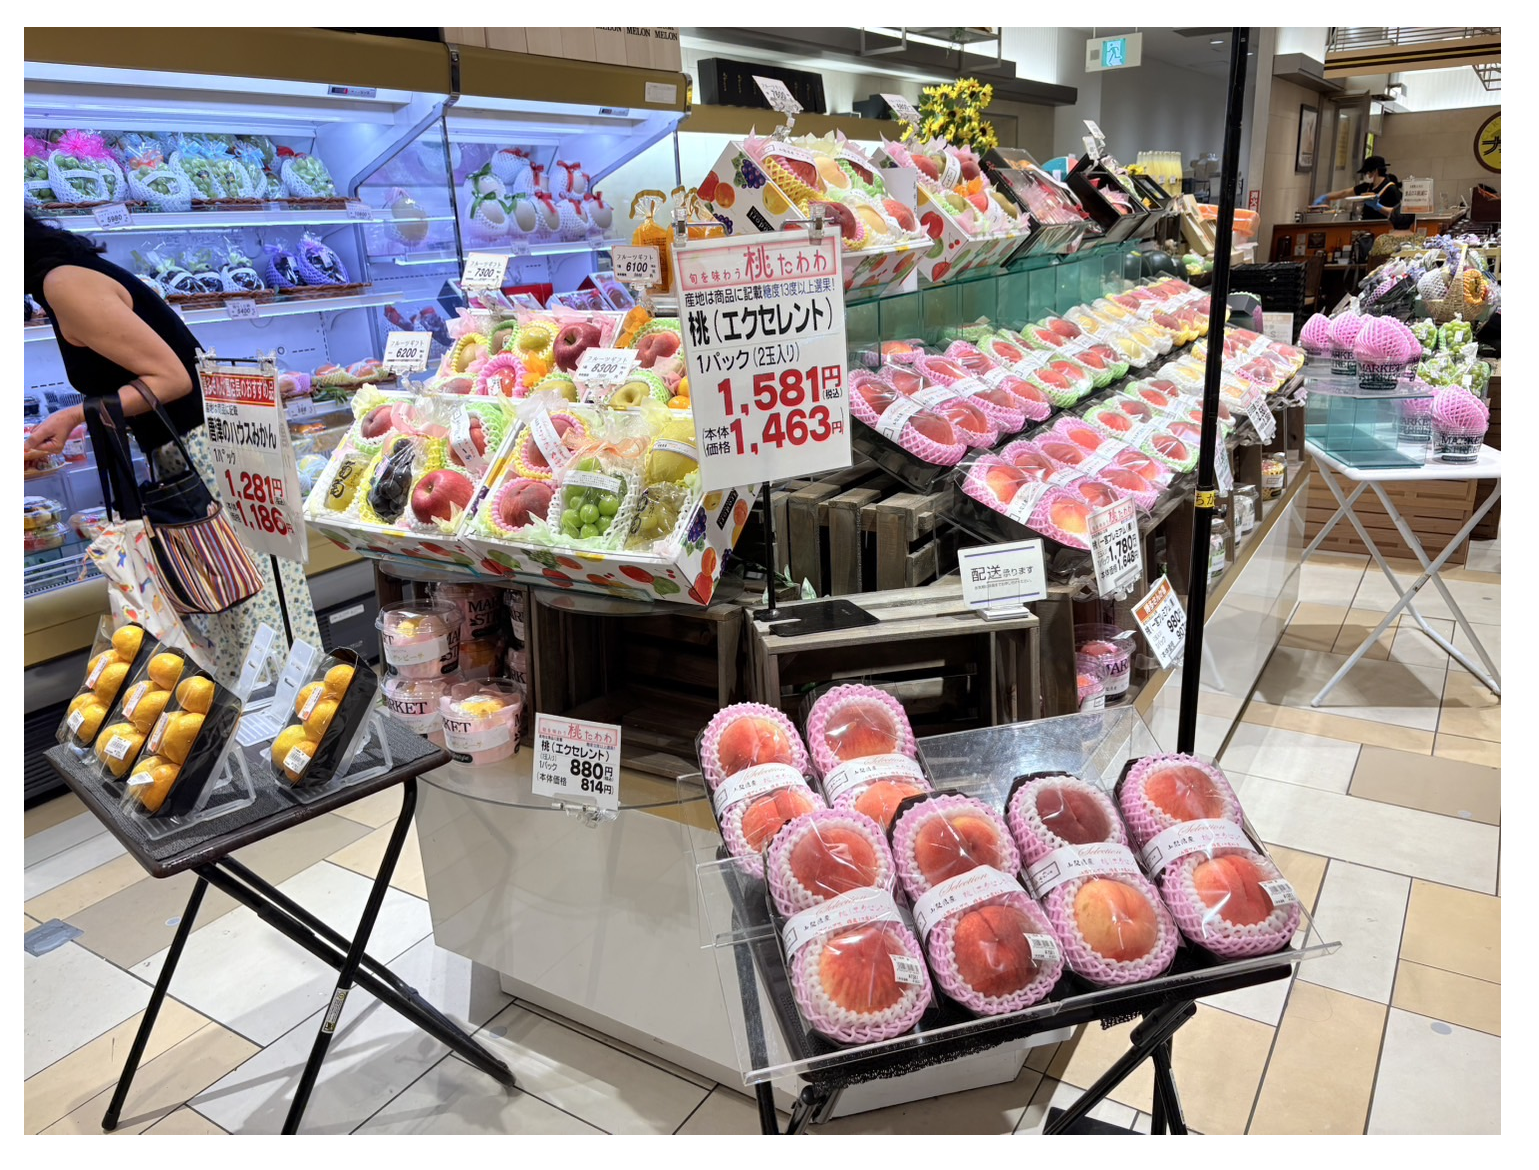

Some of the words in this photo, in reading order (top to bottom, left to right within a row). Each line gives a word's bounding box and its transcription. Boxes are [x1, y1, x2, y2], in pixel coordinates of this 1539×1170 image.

[626, 28, 651, 37] MELON
[654, 30, 678, 40] MELON
[474, 268, 495, 277] 7300
[626, 261, 648, 273] 6100
[689, 267, 740, 285] 旬を味わう
[743, 244, 828, 282] 桃たわわ
[684, 285, 763, 308] 産地は商品に記載
[688, 296, 833, 347] 桃(エクセレント)
[396, 348, 417, 358] 6200
[697, 341, 800, 374] 1パック(2玉入り)
[591, 363, 619, 374] 8300
[207, 417, 278, 450] 唐津のハウスみかん
[971, 565, 1034, 583] 配送承ります
[387, 701, 428, 715] RKET
[567, 723, 613, 743] 桃たわわ
[541, 740, 610, 762] 桃(エクセレント)
[570, 759, 613, 780] 880円
[1077, 845, 1122, 856] Selection
